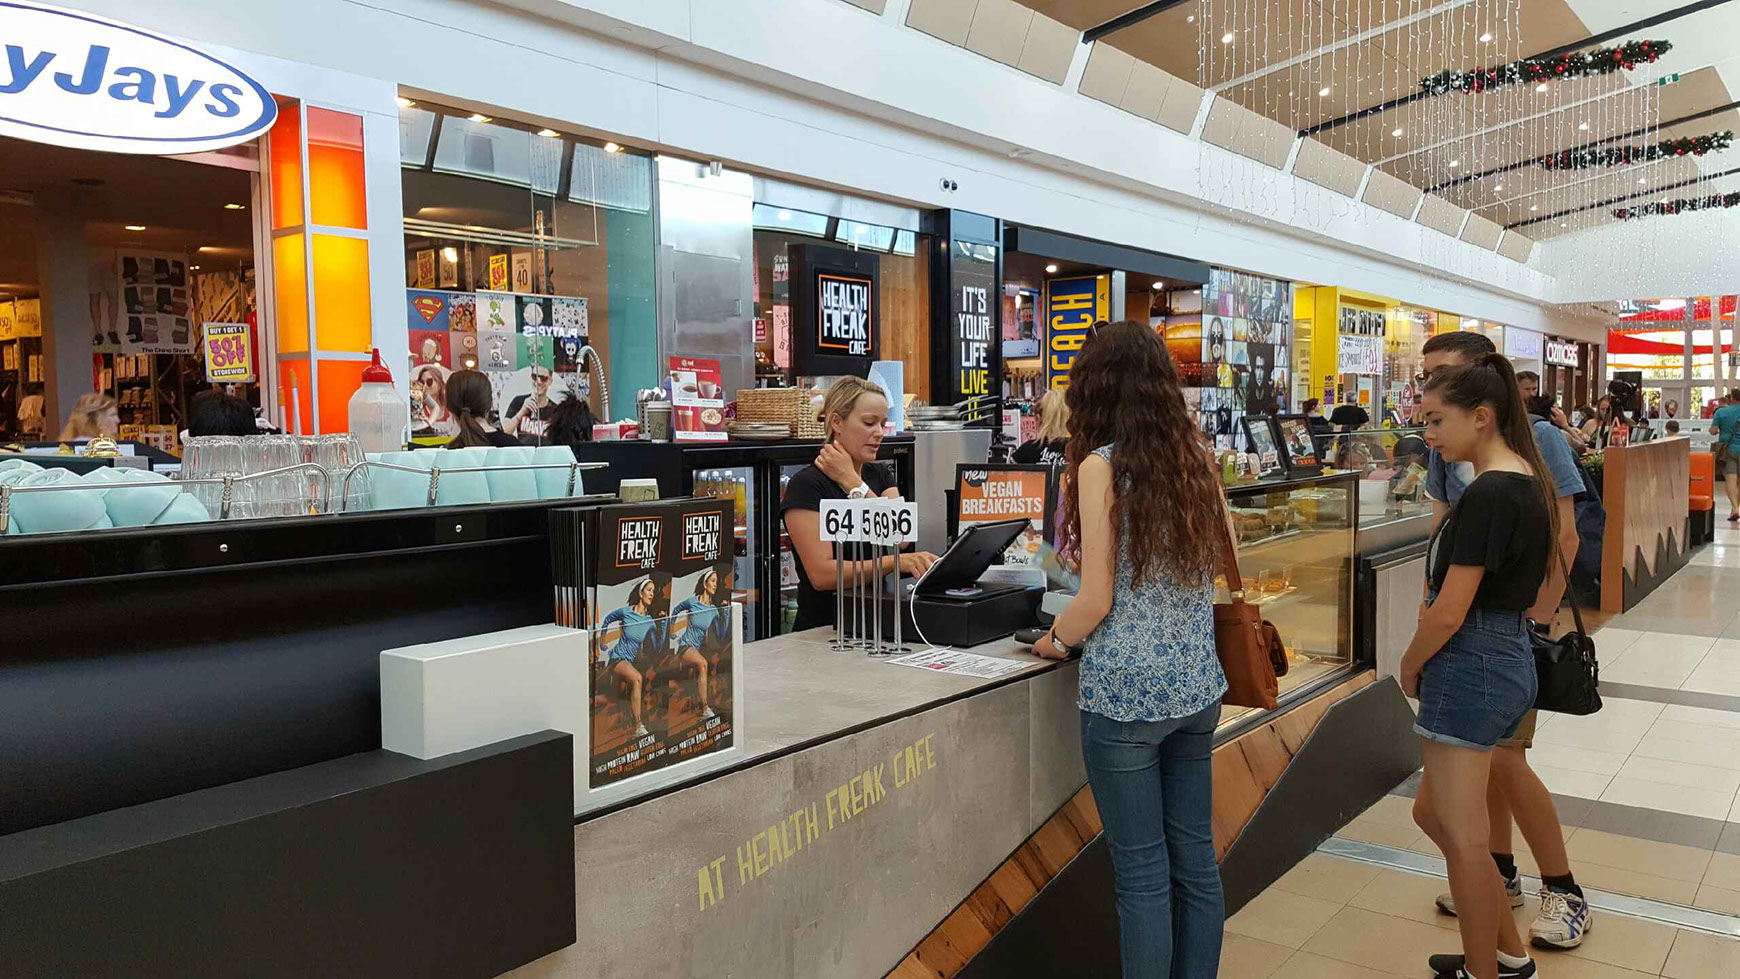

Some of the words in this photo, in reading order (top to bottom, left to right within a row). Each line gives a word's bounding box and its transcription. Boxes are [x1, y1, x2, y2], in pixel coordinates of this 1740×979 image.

[823, 280, 868, 311] HEALTH
[962, 285, 987, 314] IT'S
[823, 308, 868, 340] FREAK
[958, 312, 990, 341] YOUR
[848, 340, 867, 355] CAFE
[961, 341, 988, 368] LIFE
[212, 350, 245, 367] OFF
[960, 369, 989, 395] LIVE
[964, 469, 988, 482] new
[981, 481, 1023, 498] VEGAN
[962, 497, 1042, 515] BREAKFASTS
[621, 521, 660, 540] HEALTH
[685, 515, 720, 534] HEALTH
[825, 508, 854, 536] 64
[873, 511, 890, 539] 69
[620, 538, 658, 560] FREAK
[685, 532, 719, 554] FREAK
[641, 558, 656, 569] CAFE
[704, 551, 718, 561] CAFE
[706, 717, 721, 730] VEGAN
[638, 734, 656, 748] VEGAN
[607, 756, 627, 769] PROTEIN
[626, 750, 640, 763] RAW
[699, 855, 726, 911] AT
[736, 801, 820, 886] HEALTH
[825, 762, 886, 830] FREAK
[893, 733, 937, 789] CAFE
